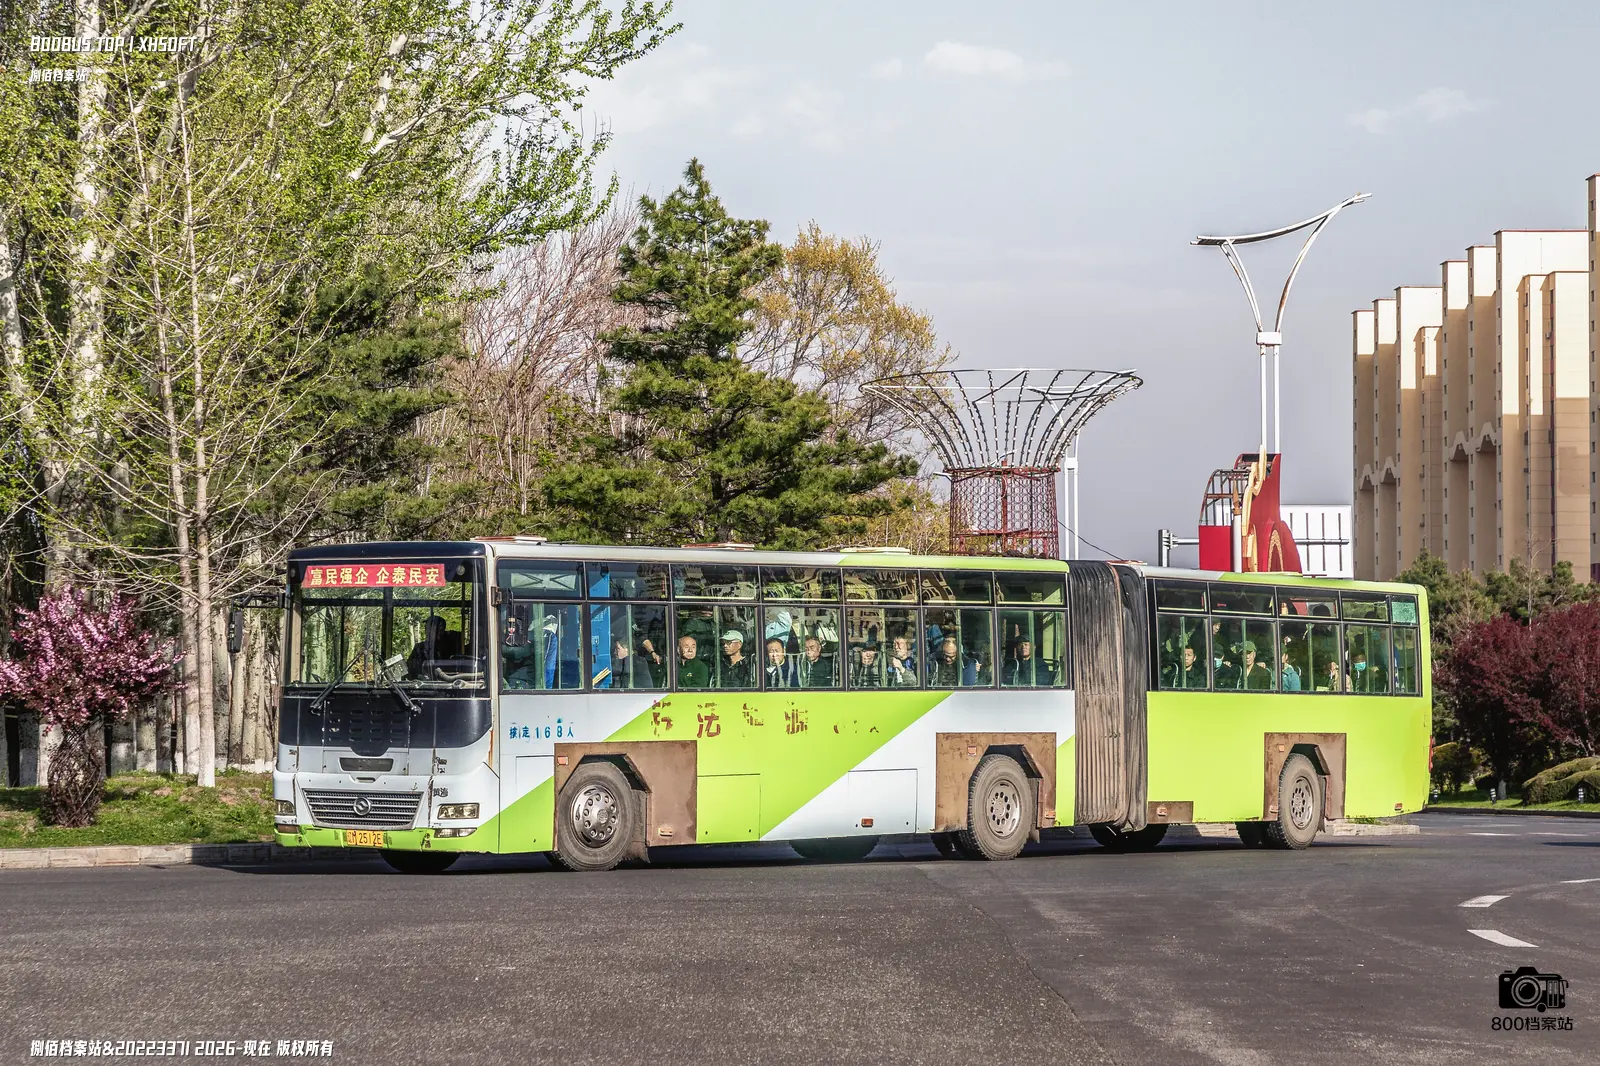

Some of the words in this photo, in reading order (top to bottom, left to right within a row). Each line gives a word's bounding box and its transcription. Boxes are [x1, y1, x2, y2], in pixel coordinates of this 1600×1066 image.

[310, 567, 369, 586] 富民强企
[376, 566, 439, 585] 企泰民安
